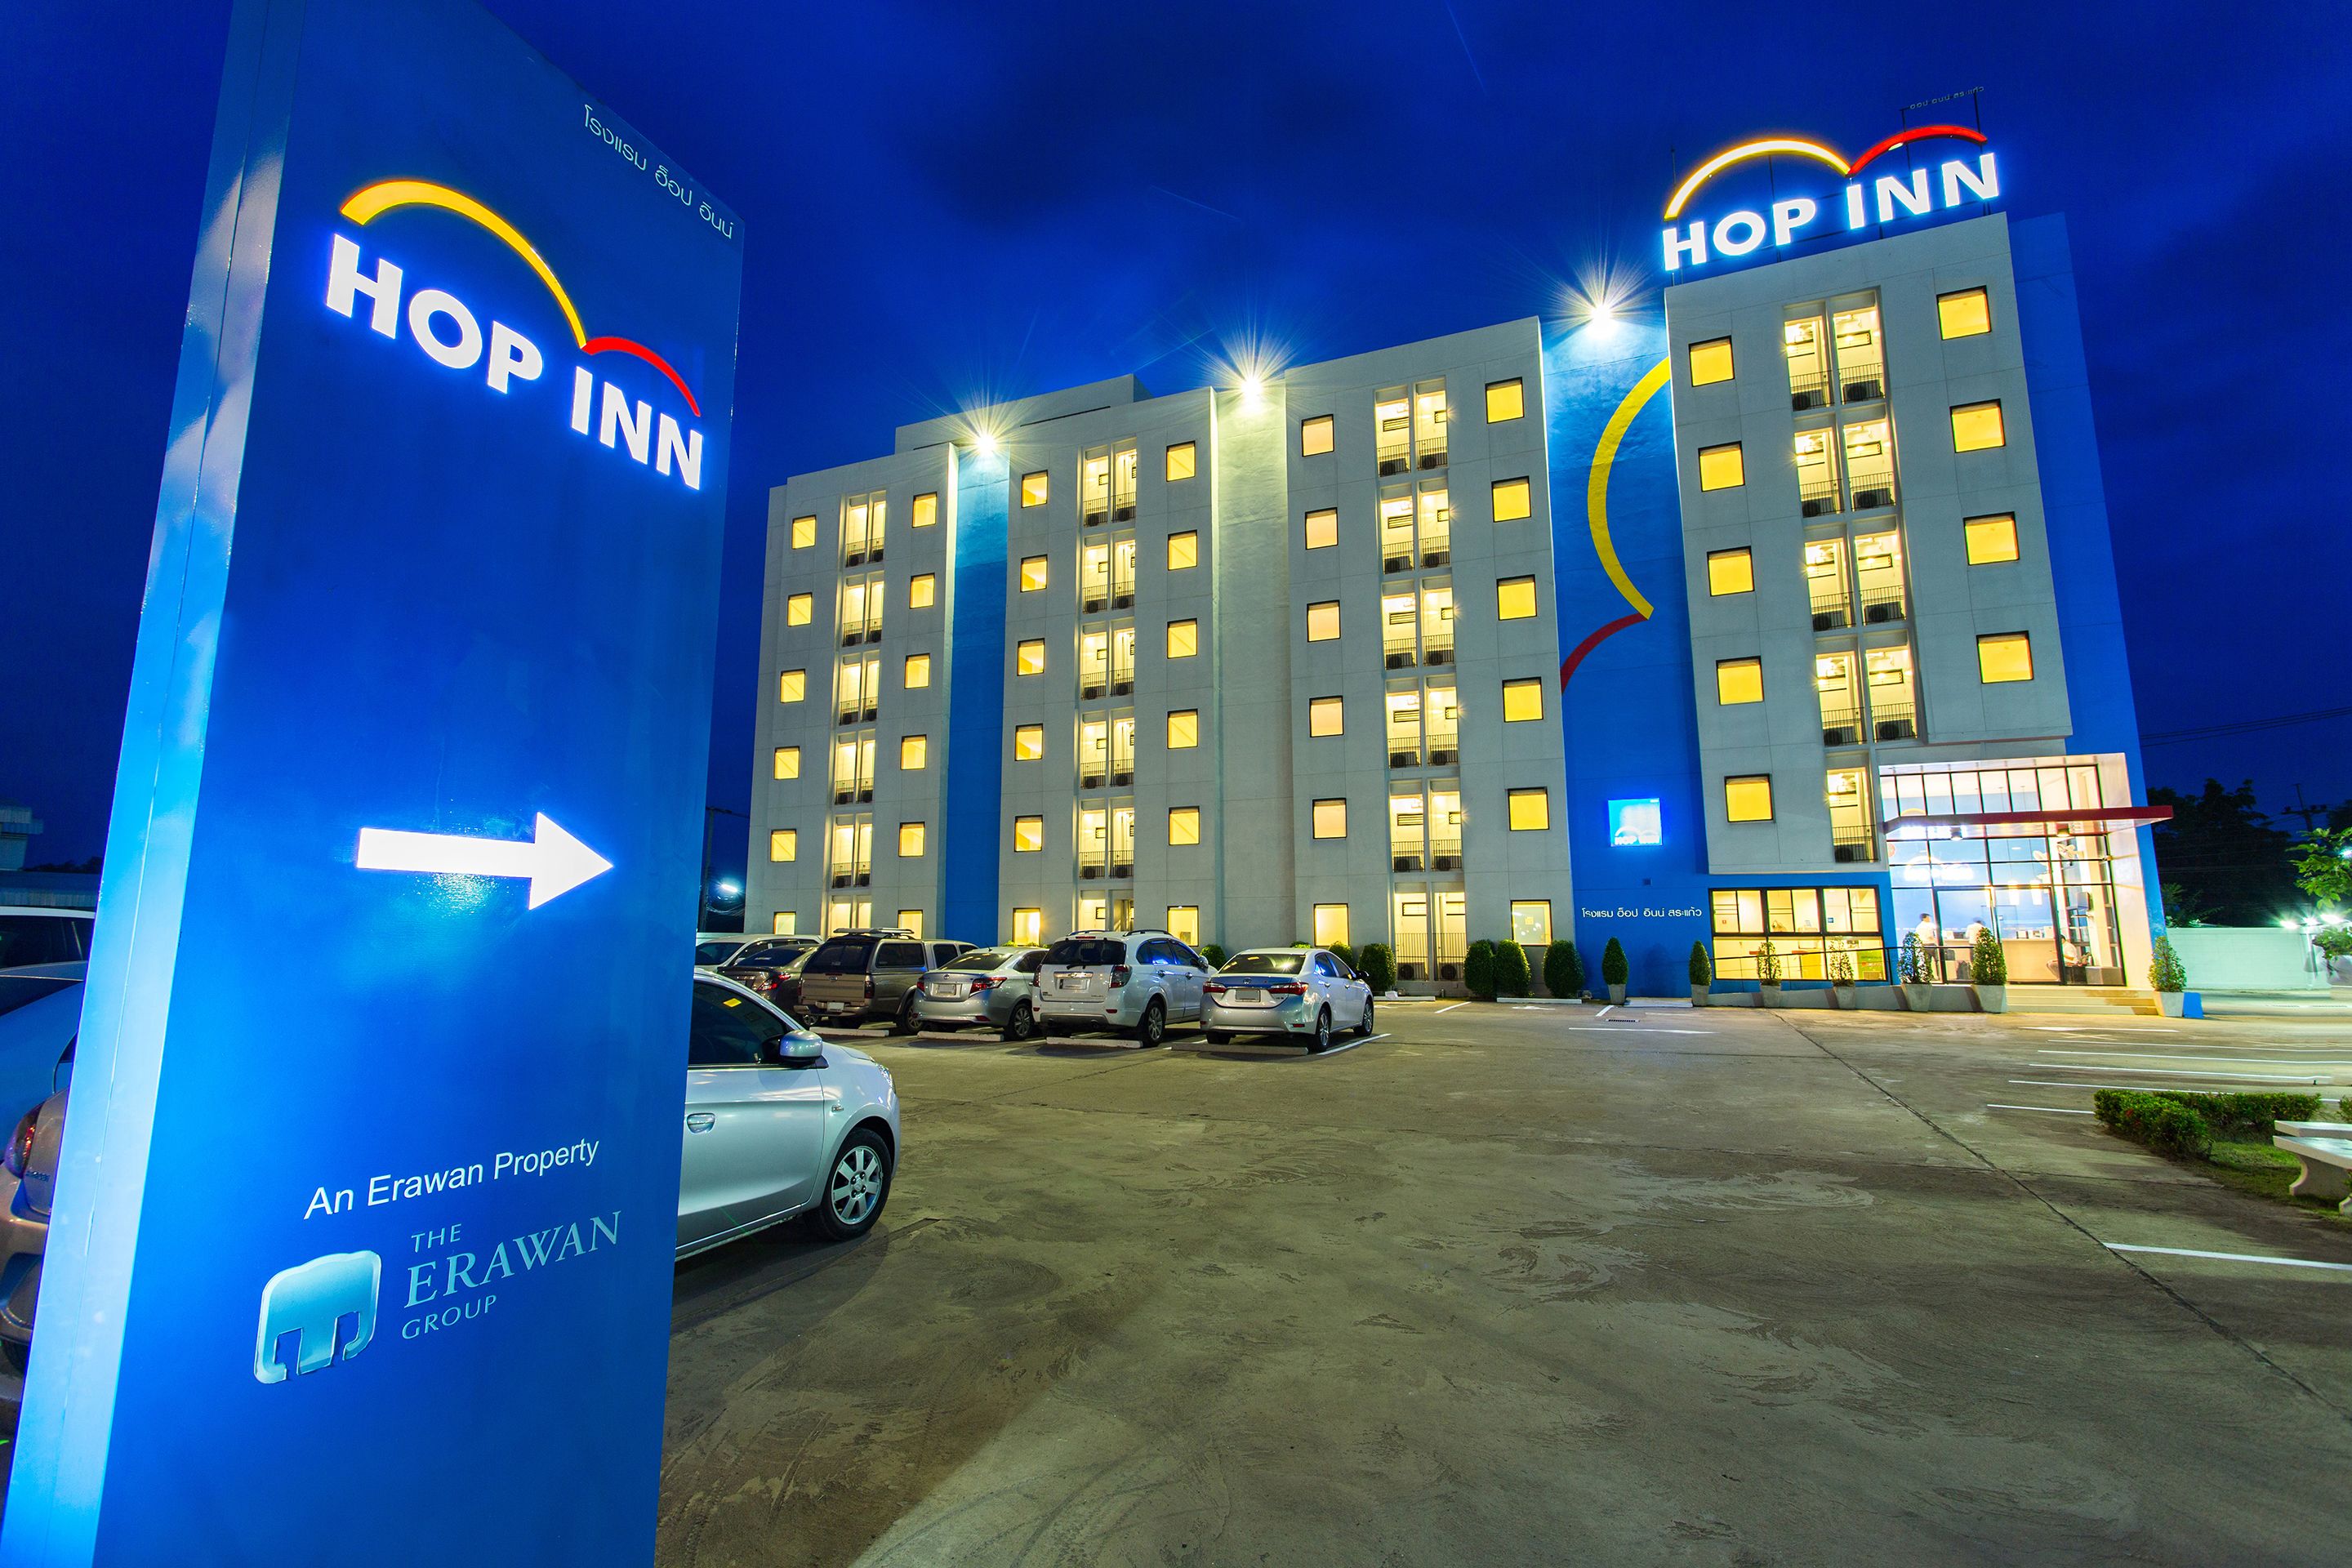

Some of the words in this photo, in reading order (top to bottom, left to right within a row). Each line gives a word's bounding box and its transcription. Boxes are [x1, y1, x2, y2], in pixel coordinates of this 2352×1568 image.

[584, 104, 647, 172] โรงแรม
[1662, 198, 1816, 271] HOP
[1846, 152, 1999, 230] INN
[326, 233, 543, 394] HOP
[571, 365, 703, 491] INN
[1581, 907, 1614, 918] โรงแรม
[1668, 906, 1703, 917] สระแก้ว
[303, 1186, 354, 1220] An
[367, 1163, 483, 1207] Erawan
[492, 1137, 599, 1181] Property
[403, 1209, 621, 1309] ERAWAN
[411, 1223, 462, 1254] THE
[401, 1294, 497, 1340] GROUP
